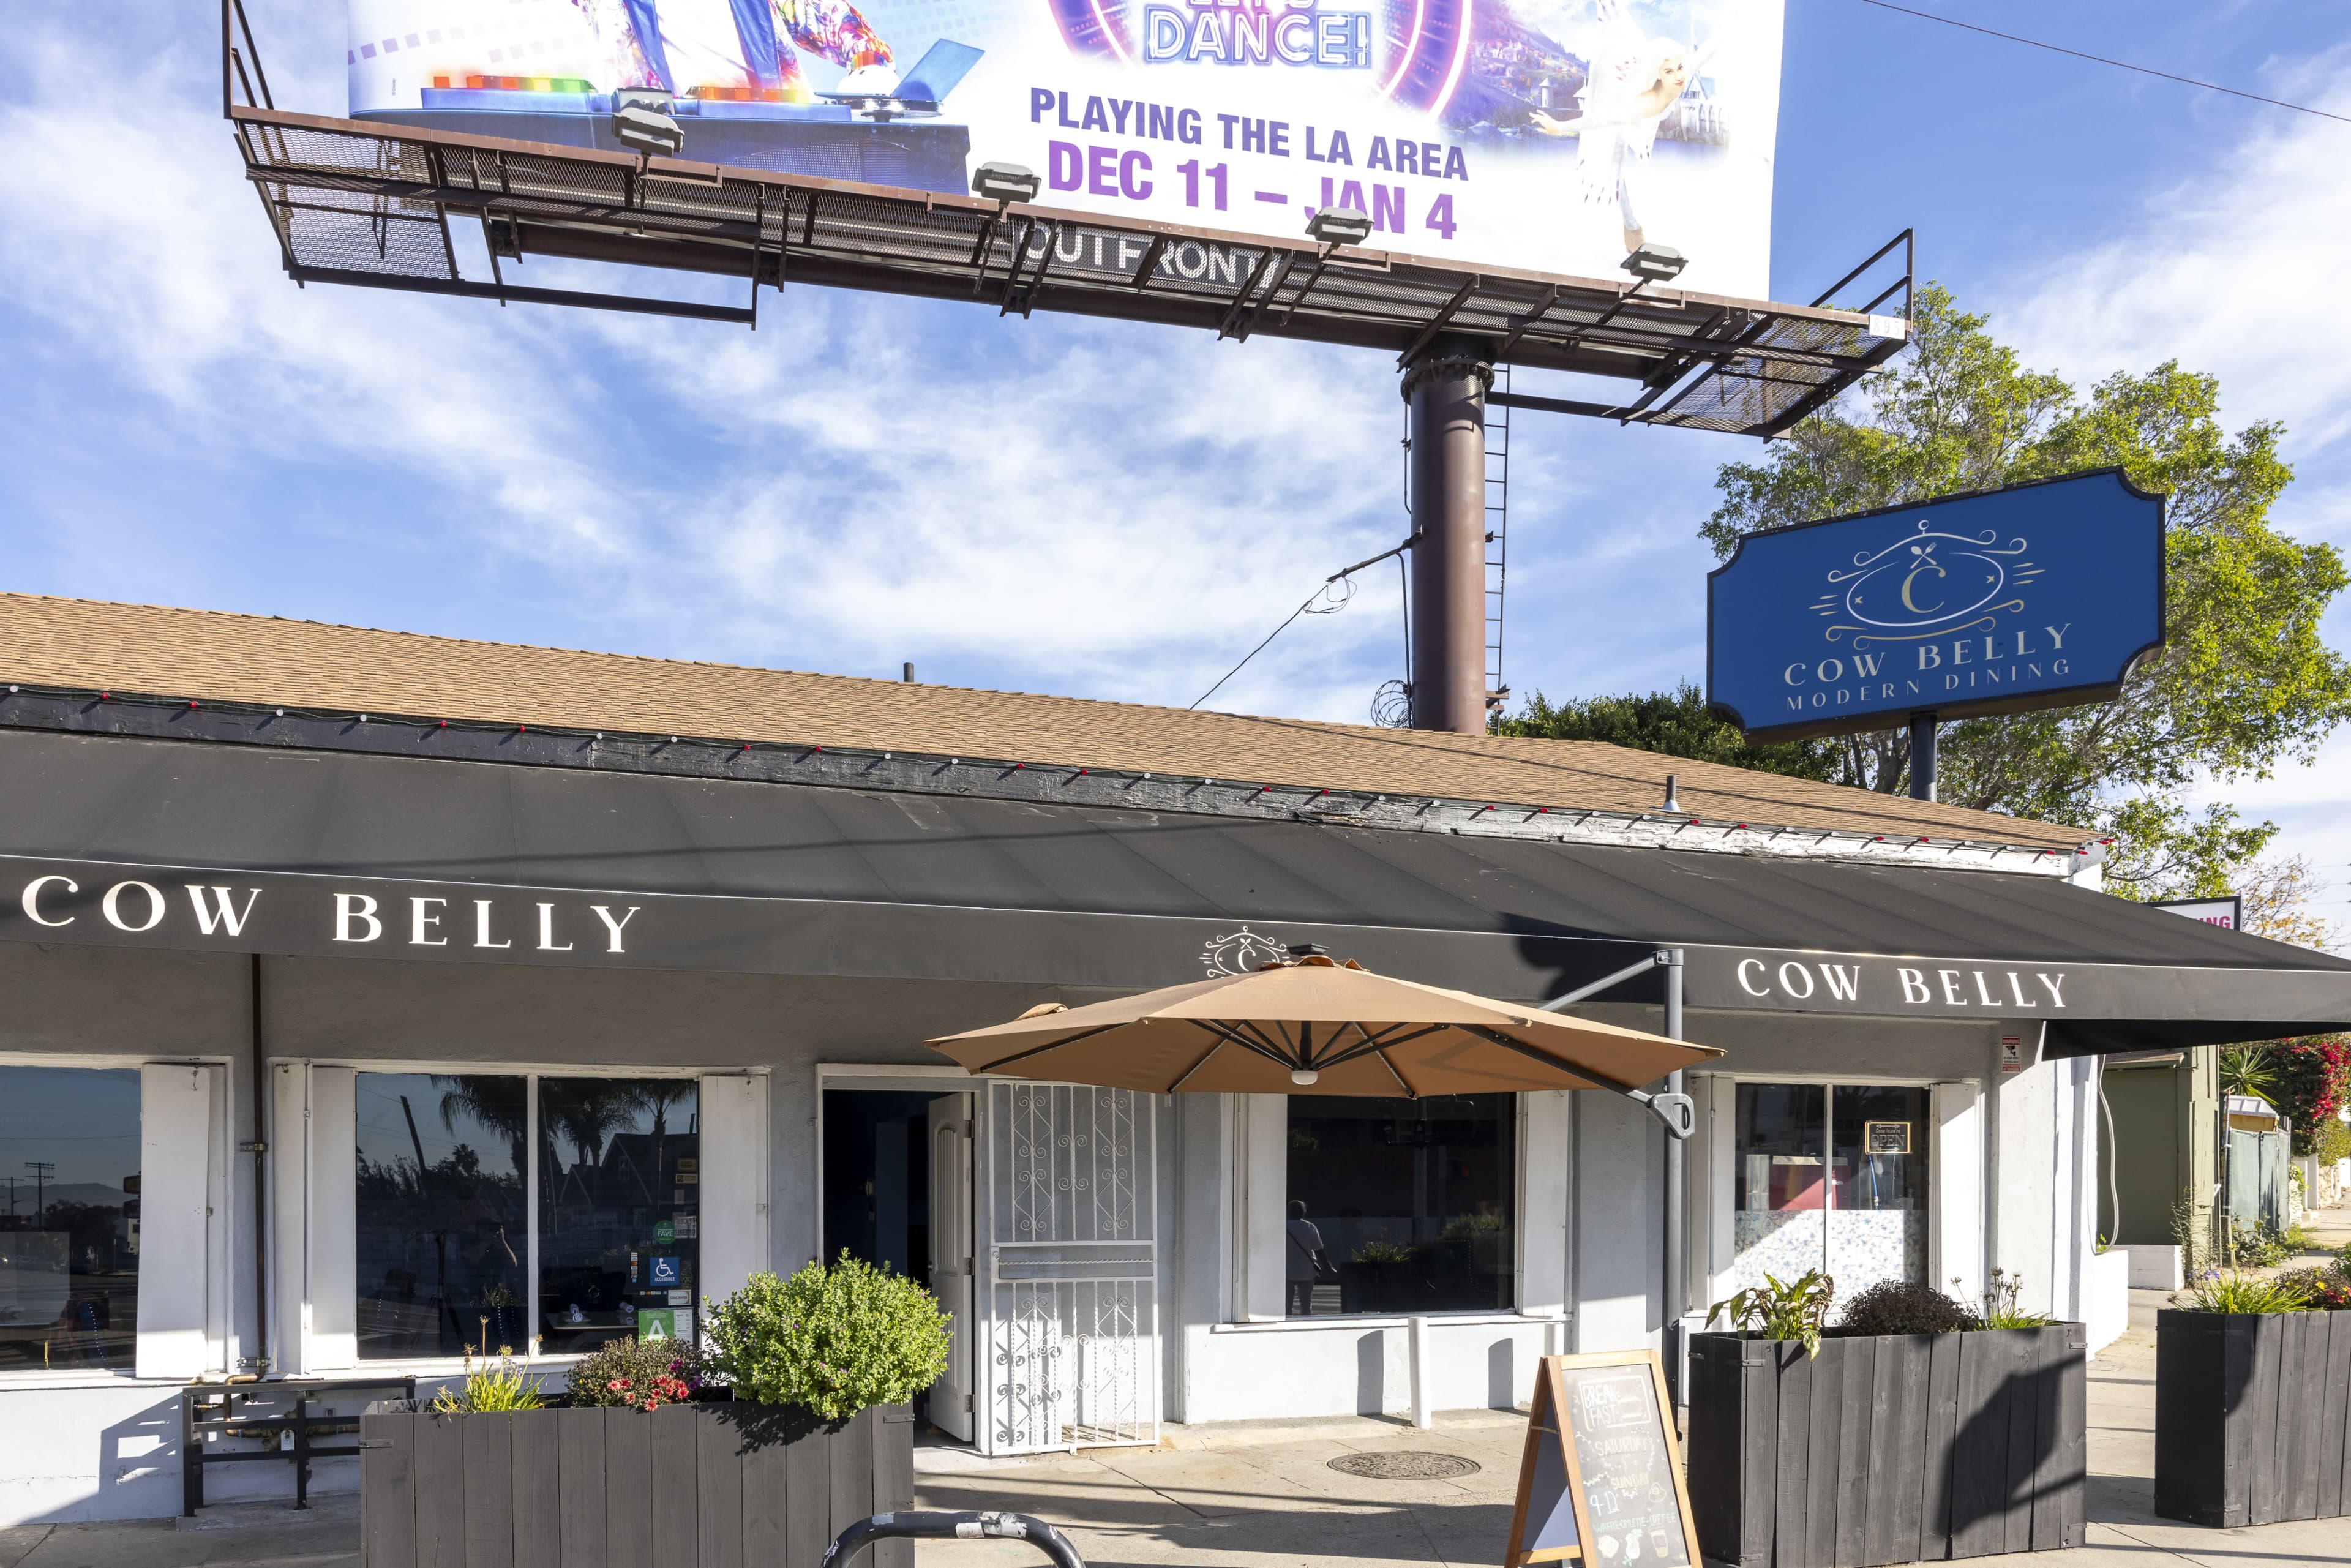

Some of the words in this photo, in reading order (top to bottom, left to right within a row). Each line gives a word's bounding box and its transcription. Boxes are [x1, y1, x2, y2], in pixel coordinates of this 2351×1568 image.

[1147, 7, 1370, 67] DANCE!
[1031, 88, 1201, 144] PLAYING
[1218, 113, 1289, 157] THE
[1306, 126, 1353, 165] LA
[1367, 136, 1468, 181] AREA
[1049, 140, 1152, 200] DEC
[1177, 159, 1227, 211] 11
[1304, 176, 1406, 234] JAN
[1426, 194, 1457, 239] 4
[1902, 566, 1946, 613] C
[1784, 652, 1886, 686] COW
[1918, 623, 2071, 670] BELLY
[1787, 680, 1919, 711] MODERN
[1946, 659, 2070, 691] DINING
[22, 876, 262, 936] COW
[332, 893, 640, 952] BELLY
[1738, 959, 1860, 1001] COW
[1897, 968, 2066, 1008] BELLY
[1870, 1134, 1905, 1146] OPEN
[646, 1319, 667, 1341] A
[1582, 1382, 1618, 1409] BREAK
[1589, 1405, 1617, 1428] FAST
[1595, 1436, 1647, 1457] SATURDAY
[1589, 1490, 1621, 1517] 9-12
[1611, 1472, 1649, 1490] SUNDAY
